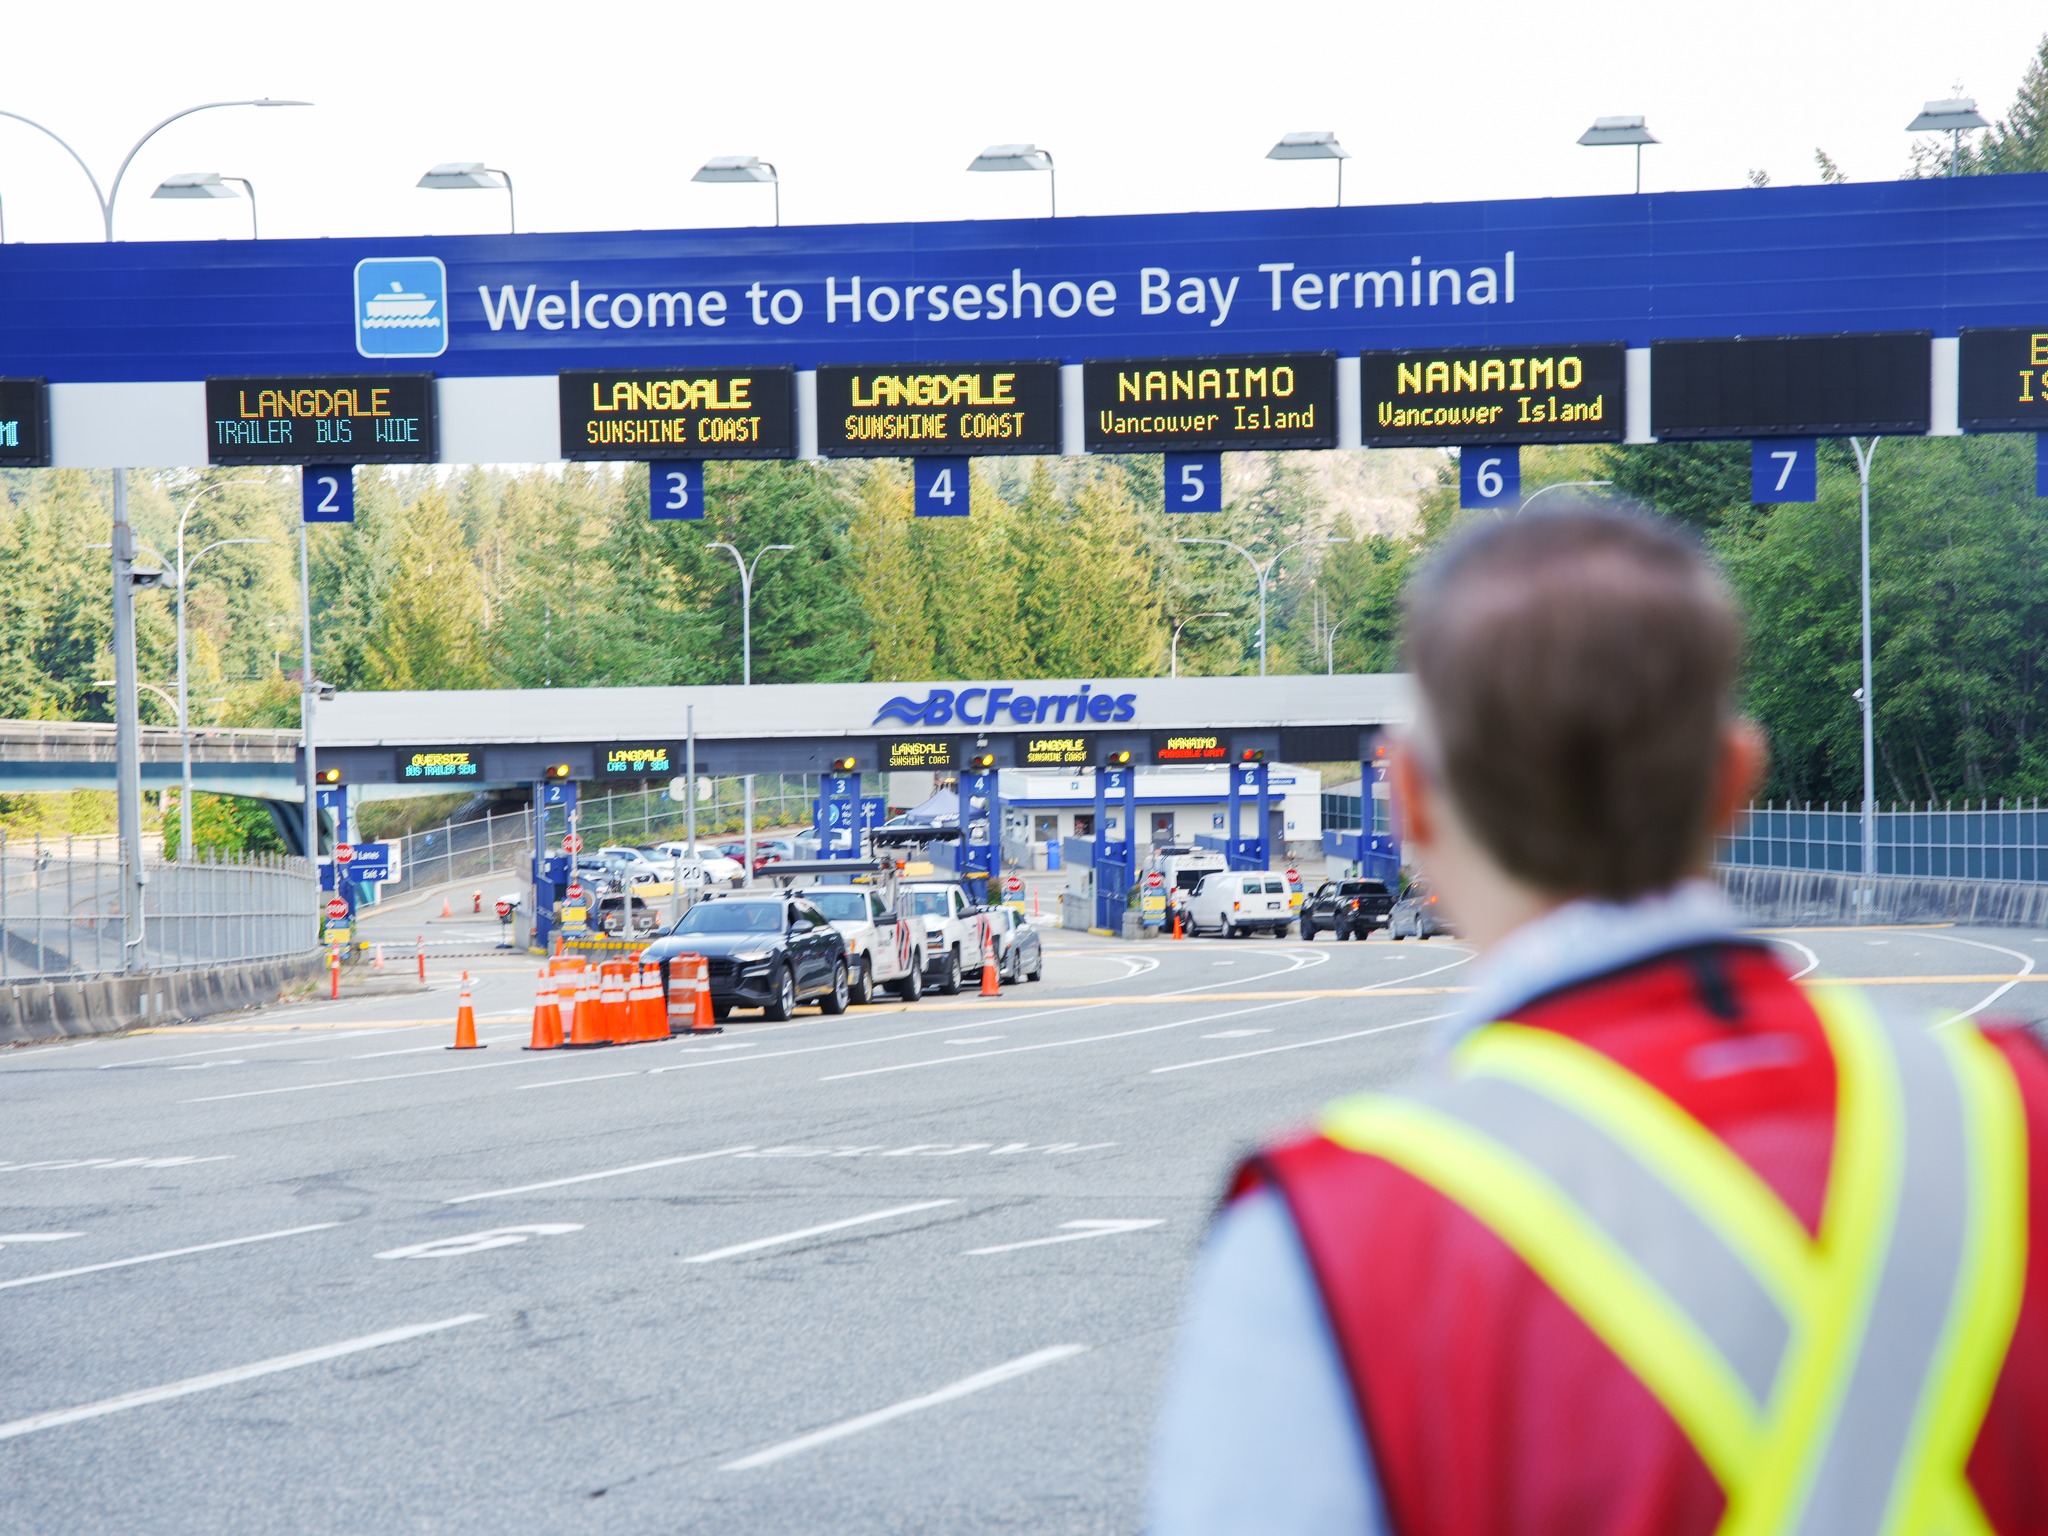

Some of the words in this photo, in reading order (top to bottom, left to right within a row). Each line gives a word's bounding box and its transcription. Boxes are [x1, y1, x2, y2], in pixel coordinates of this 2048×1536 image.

[479, 279, 727, 331] Welcome
[745, 281, 803, 325] to
[825, 268, 1117, 323] Horseshoe
[1139, 267, 1240, 327] Bay
[1258, 251, 1515, 312] Terminal
[1118, 366, 1294, 402] NANAIMO
[1397, 356, 1582, 394] NANAIMO
[239, 388, 391, 418] LANGDALE
[593, 378, 752, 411] LANGDALE
[851, 373, 1016, 407] LANGDALE
[1100, 410, 1219, 434] Vancouver
[1234, 403, 1314, 431] Island
[1378, 401, 1503, 427] Vancouver
[1517, 394, 1603, 423] Island
[215, 420, 293, 444] TRAILER
[315, 419, 352, 443] BUS
[375, 418, 420, 442] WIDE
[587, 418, 686, 444] SUNSHINE
[698, 416, 761, 442] COAST
[845, 414, 948, 440] SUNSHINE
[960, 412, 1025, 438] COAST
[1181, 464, 1205, 503] 5
[1476, 458, 1503, 498] 6
[1770, 451, 1798, 491] 7
[317, 476, 340, 513] 2
[665, 472, 688, 510] 3
[928, 468, 955, 506] 4
[922, 684, 1137, 727] BCFerries
[608, 748, 667, 762] LANGDALE
[891, 742, 947, 756] LANGDALE
[1029, 739, 1085, 752] LANGDALE
[1168, 736, 1217, 750] NANAIMO
[405, 765, 423, 777] BUS
[424, 764, 456, 776] TRAILER
[889, 755, 925, 766] SUNSHINE
[928, 755, 950, 765] COAST
[835, 779, 846, 793] 3
[974, 777, 985, 790] 4
[1110, 773, 1120, 787] 5
[1245, 770, 1255, 784] 6
[321, 792, 330, 806] 1
[550, 786, 561, 801] 2
[683, 866, 701, 880] 20
